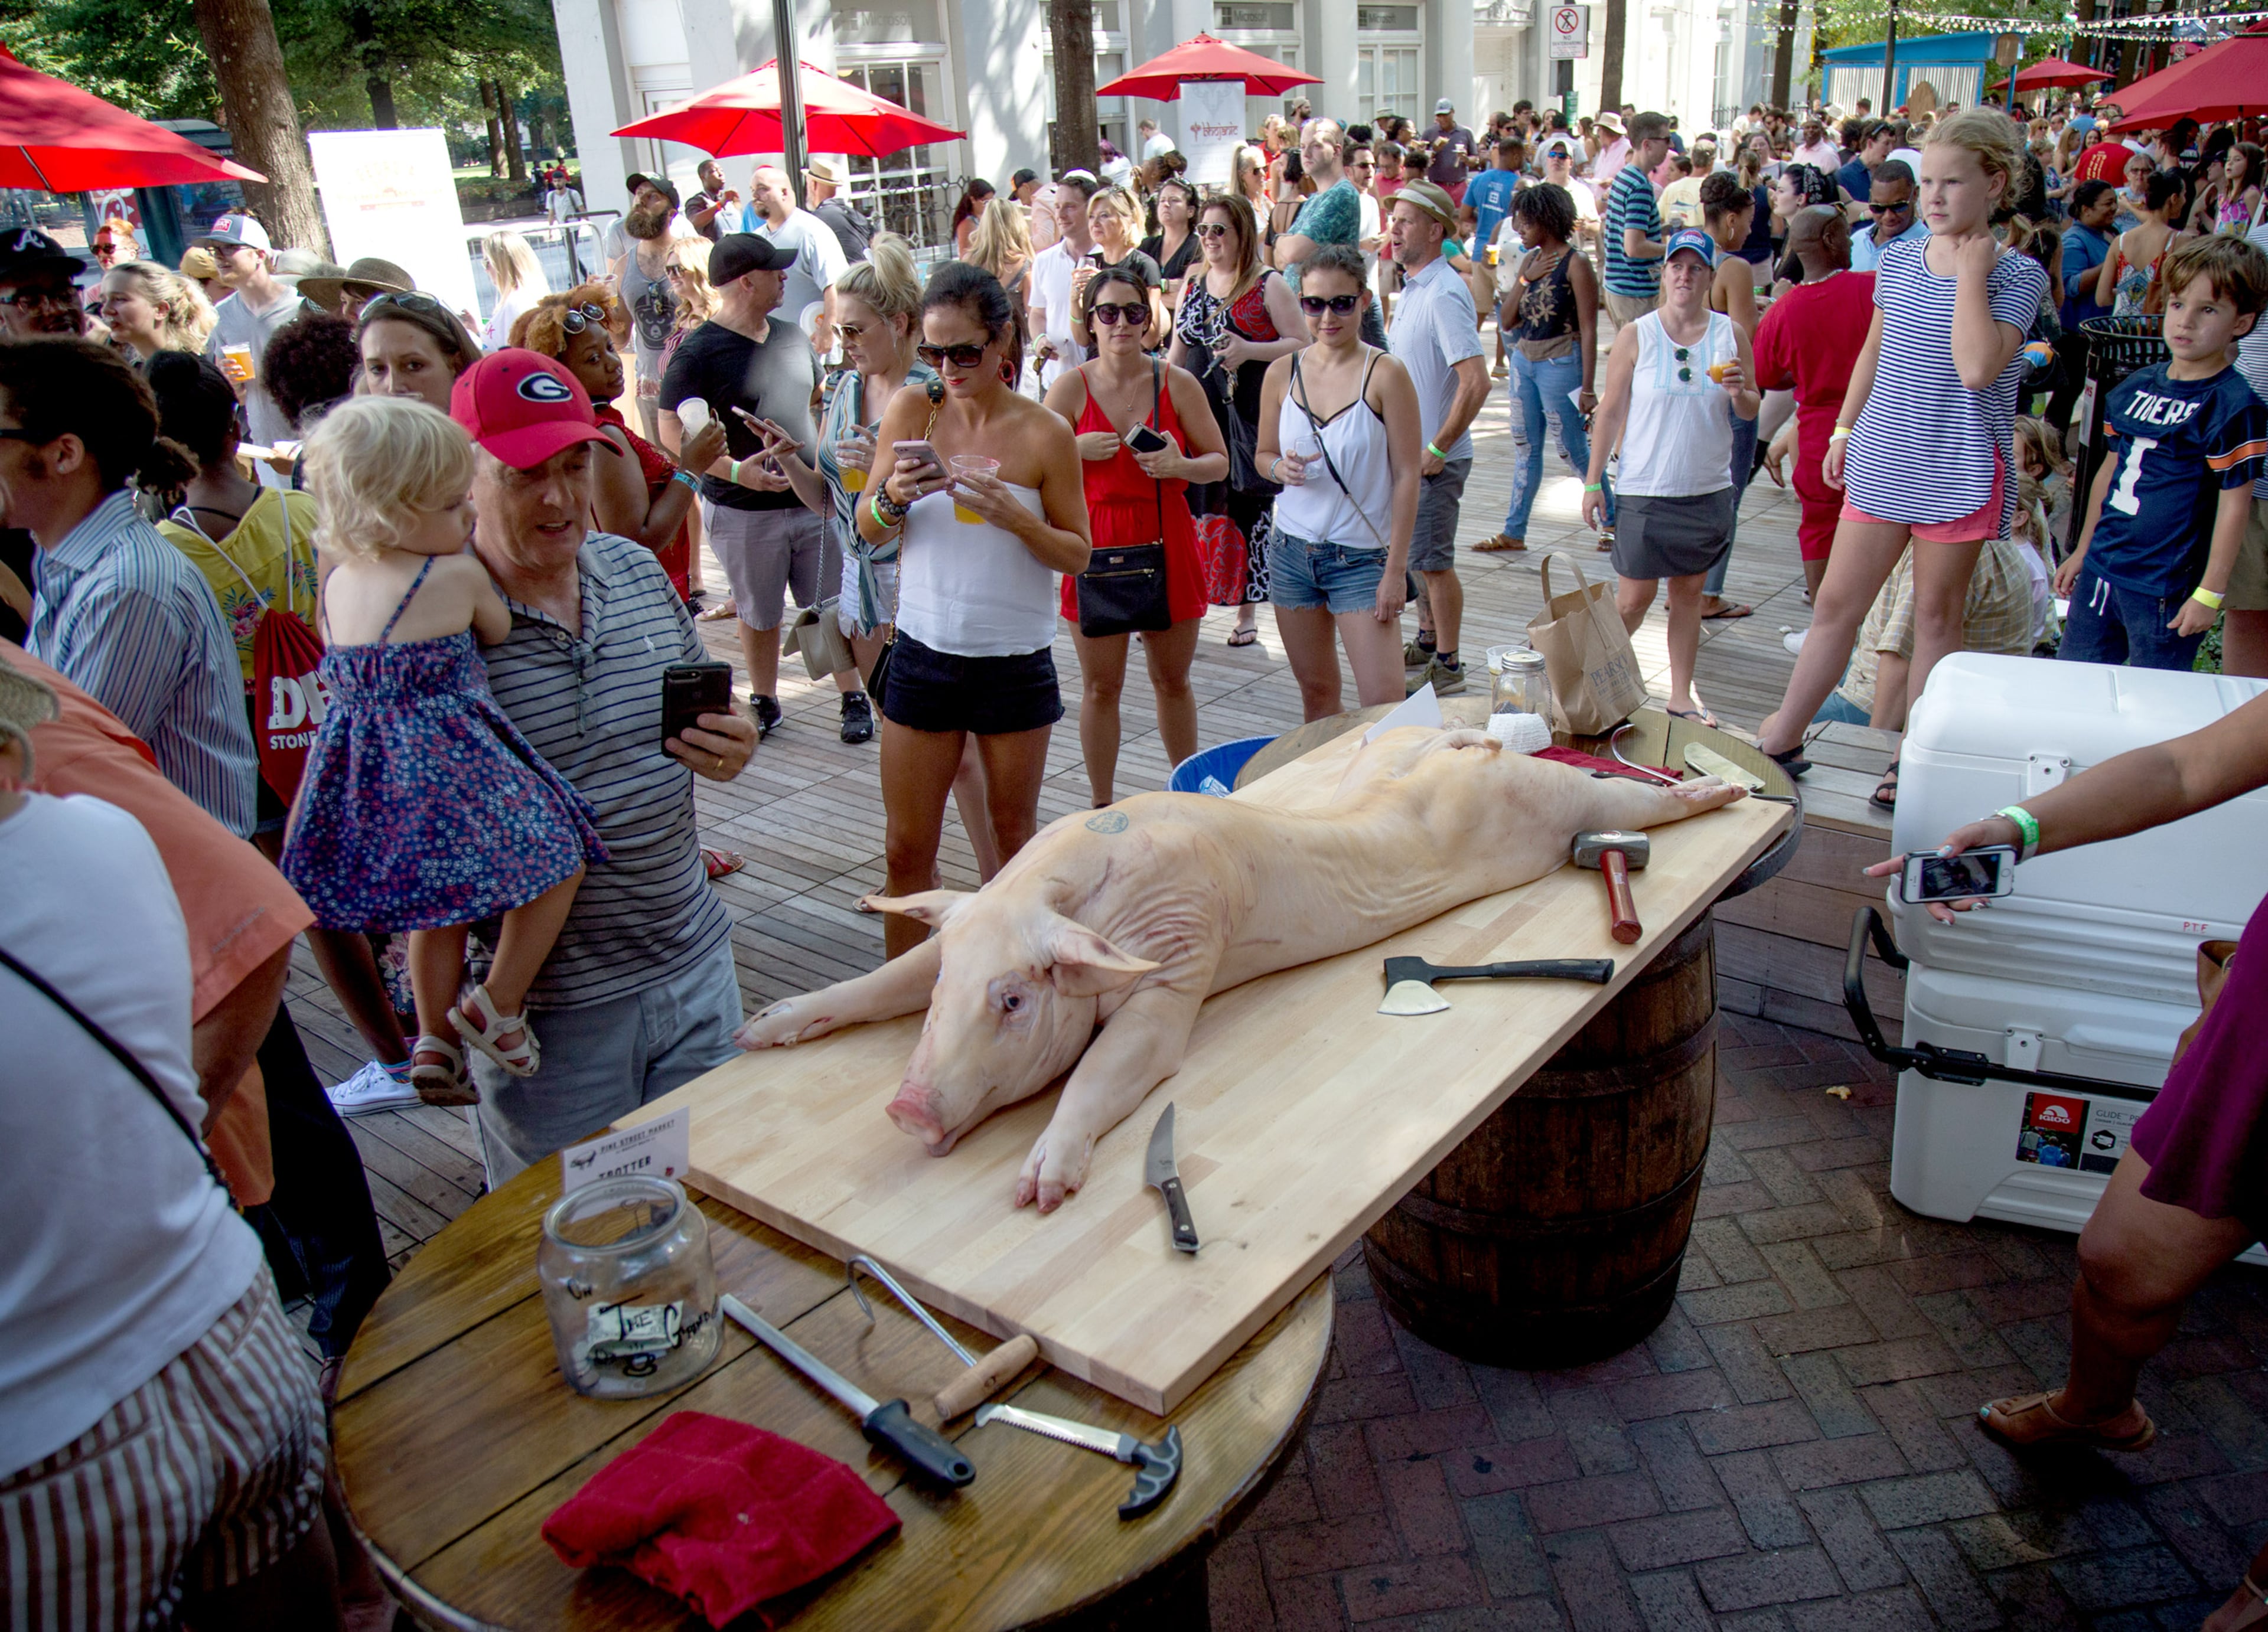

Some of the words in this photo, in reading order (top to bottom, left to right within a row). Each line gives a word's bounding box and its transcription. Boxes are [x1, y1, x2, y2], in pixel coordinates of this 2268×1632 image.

[1233, 9, 1268, 22] Microsoft
[1368, 12, 1396, 24] Microsoft
[523, 374, 571, 400] G
[2124, 390, 2201, 425] TIGERS
[2096, 1109, 2122, 1120] GLIDE
[620, 1131, 646, 1147] STREET
[648, 1119, 674, 1137] MARKET
